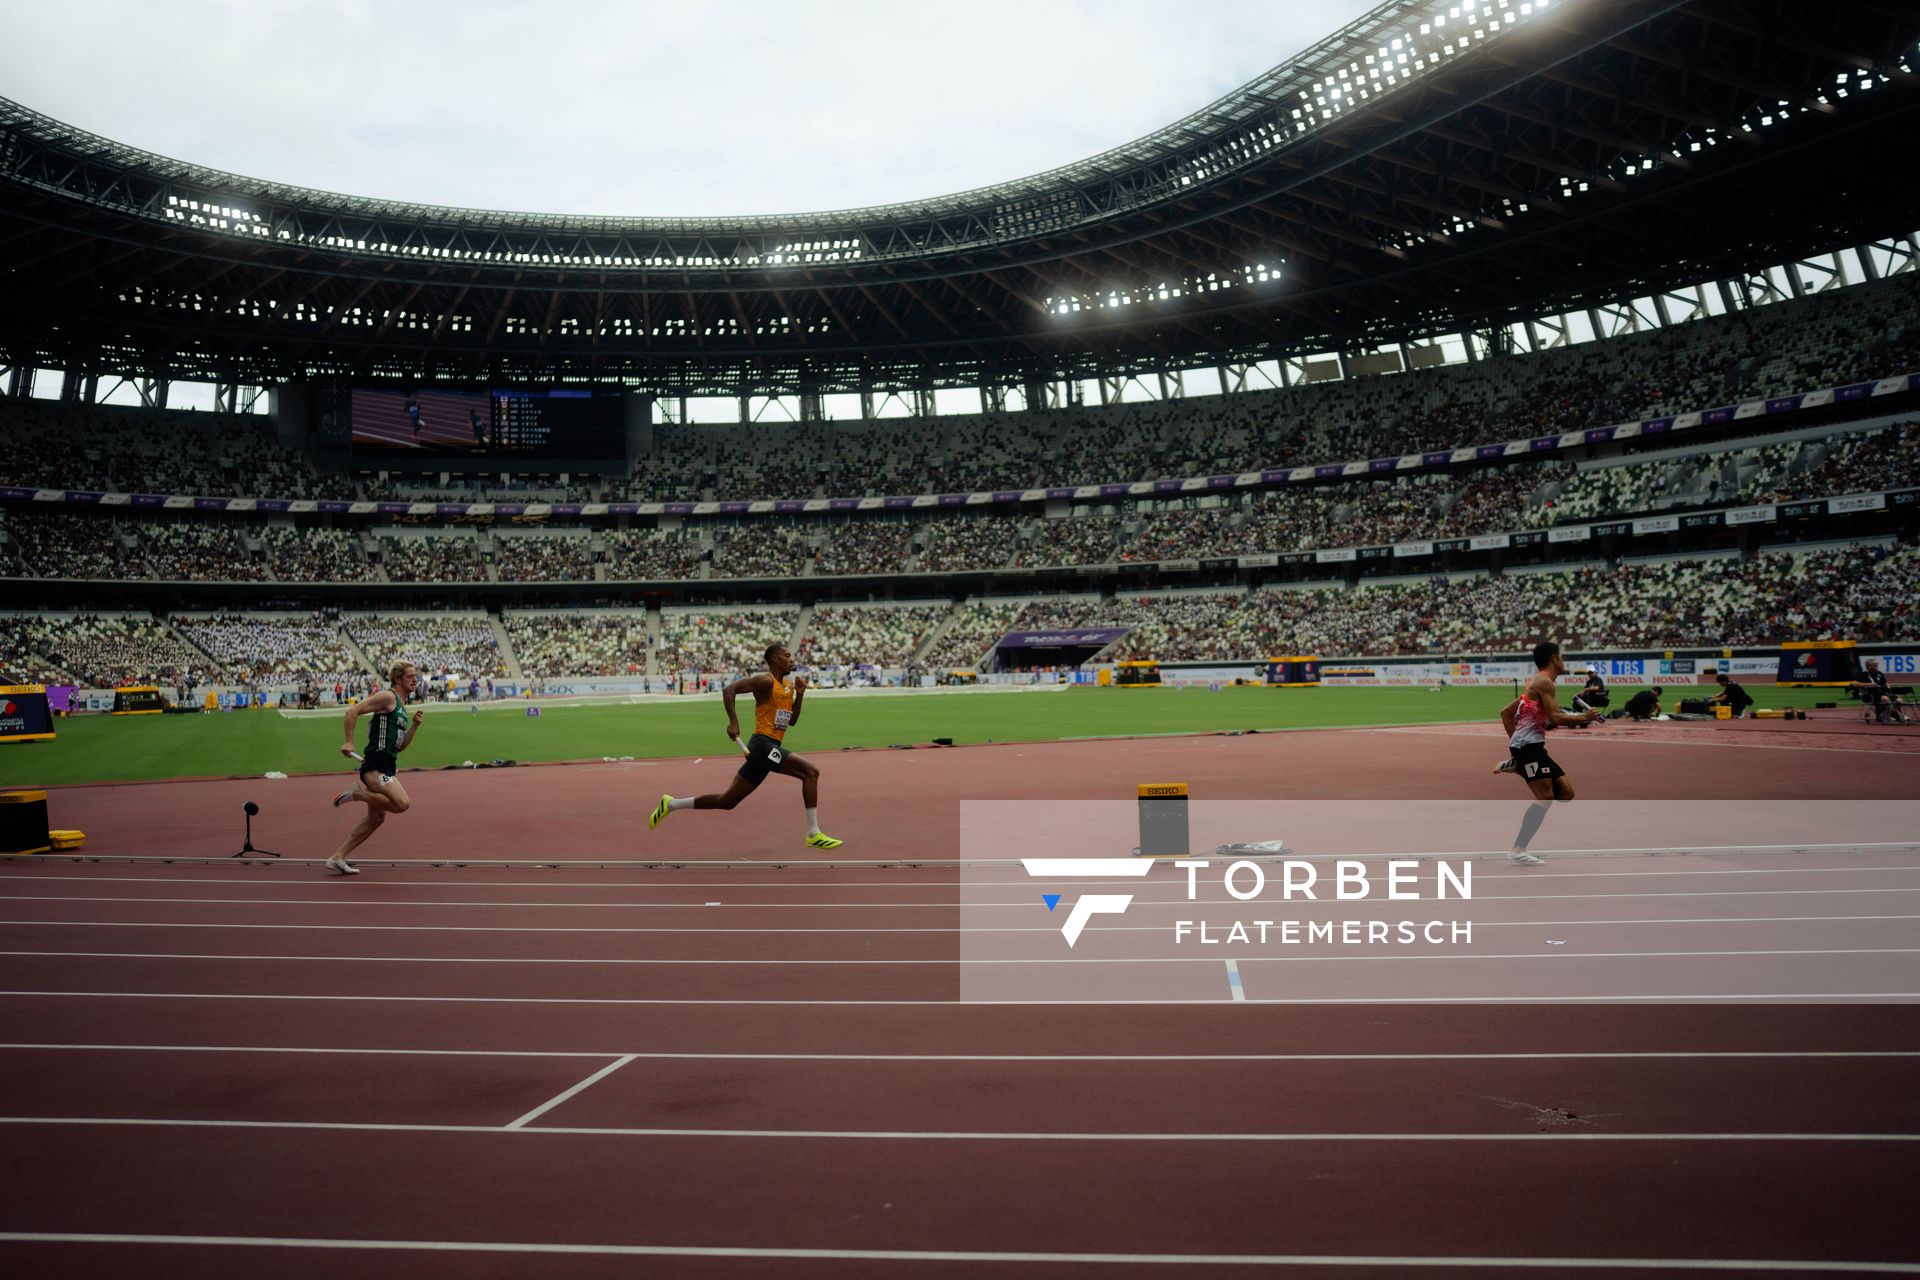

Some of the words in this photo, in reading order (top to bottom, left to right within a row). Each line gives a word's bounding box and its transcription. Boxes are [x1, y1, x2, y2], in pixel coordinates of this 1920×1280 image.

[1615, 660, 1640, 674] TBS
[1884, 656, 1915, 672] TBS
[1607, 676, 1644, 684] HONDA
[1147, 787, 1179, 795] SEIKO
